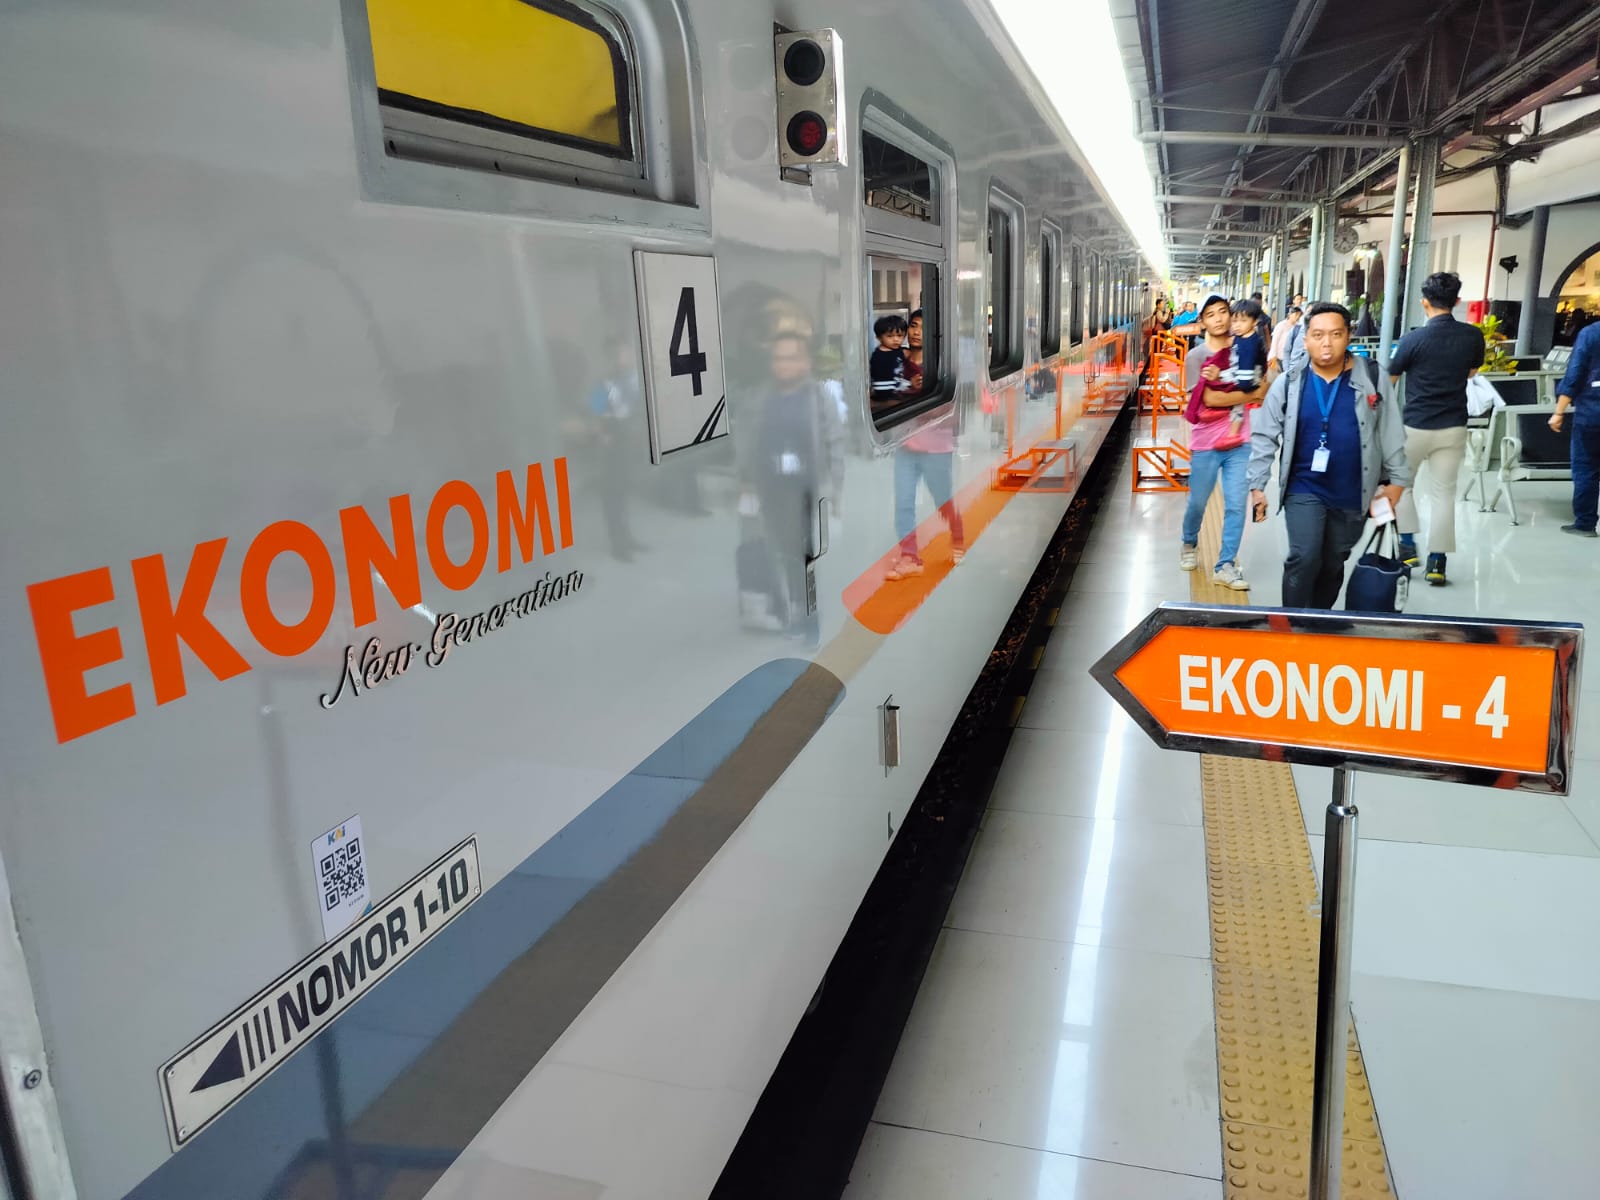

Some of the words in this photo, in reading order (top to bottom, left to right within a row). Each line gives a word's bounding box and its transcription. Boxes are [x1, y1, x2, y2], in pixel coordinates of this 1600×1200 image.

[669, 287, 707, 396] 4
[26, 457, 574, 744] EKONOMI
[320, 637, 422, 709] New
[426, 571, 584, 668] Generation
[1178, 654, 1424, 731] EKONOMI
[1475, 676, 1509, 738] 4
[277, 907, 409, 1045] NOMOR
[414, 858, 469, 933] 1-10
